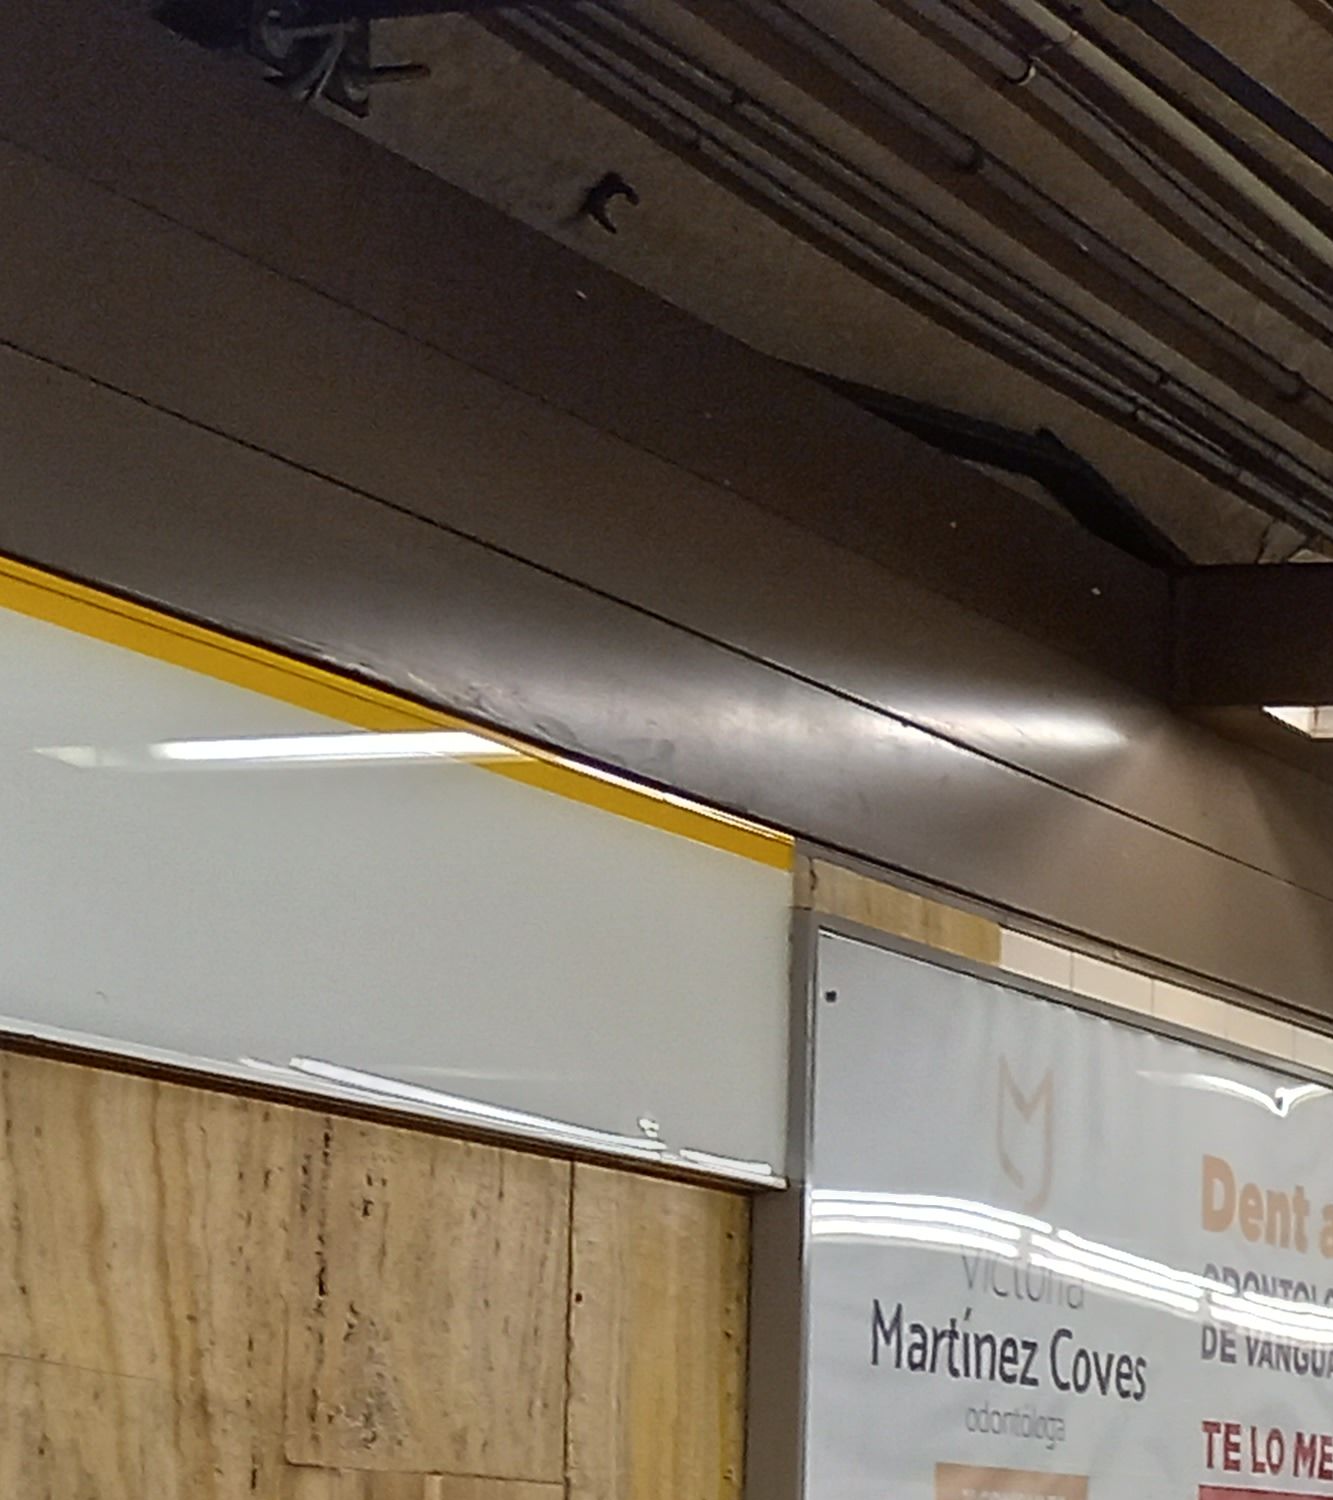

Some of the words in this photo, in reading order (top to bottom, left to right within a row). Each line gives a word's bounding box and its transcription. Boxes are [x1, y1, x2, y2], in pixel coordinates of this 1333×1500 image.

[1202, 1153, 1311, 1255] Dent
[870, 1299, 1039, 1387] Martínez
[1049, 1328, 1147, 1402] Coves
[1201, 1323, 1238, 1364] DE
[1202, 1420, 1242, 1473] TE
[1249, 1426, 1286, 1476] LO
